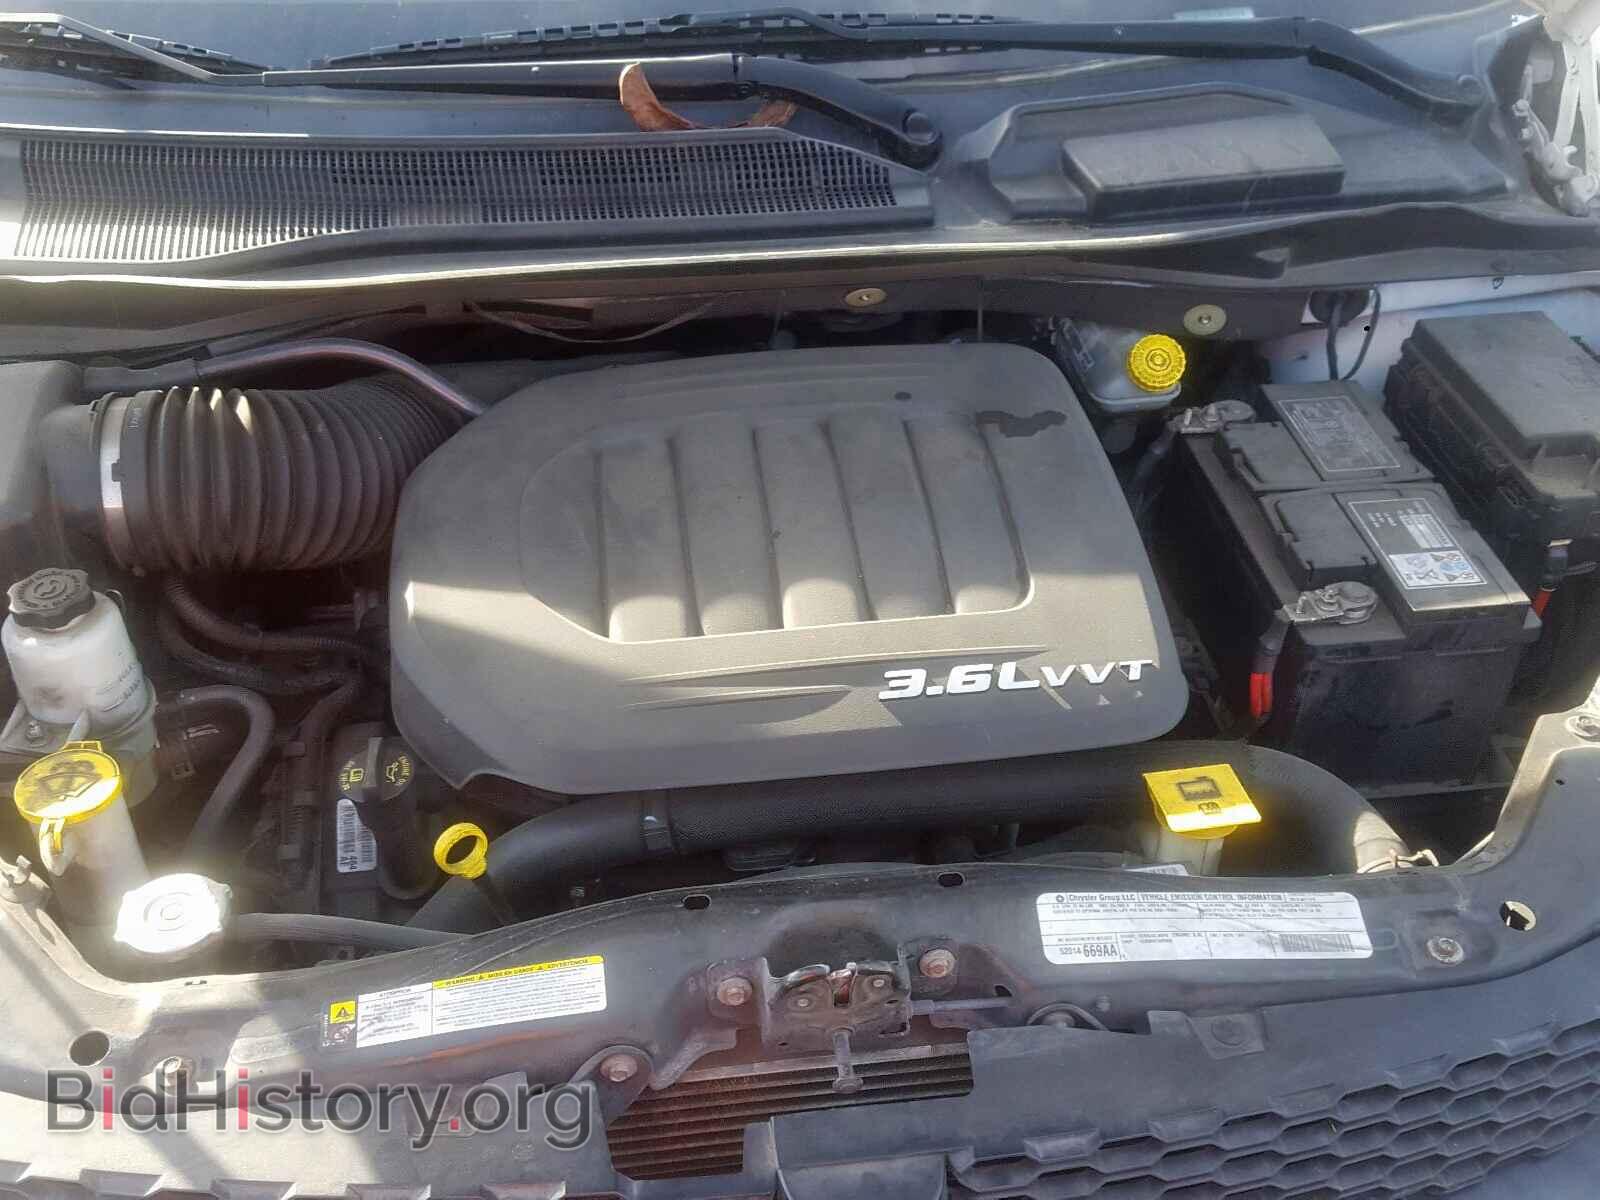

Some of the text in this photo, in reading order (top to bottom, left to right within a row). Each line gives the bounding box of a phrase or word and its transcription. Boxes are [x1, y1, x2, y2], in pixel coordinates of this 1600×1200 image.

[879, 659, 1153, 700] 3.6L VVT
[1068, 894, 1097, 903] Chrysler
[1099, 894, 1122, 903] Group
[1141, 894, 1169, 902] VEHICLE
[1237, 893, 1283, 901] INFORMATION
[1083, 944, 1118, 958] 669AA
